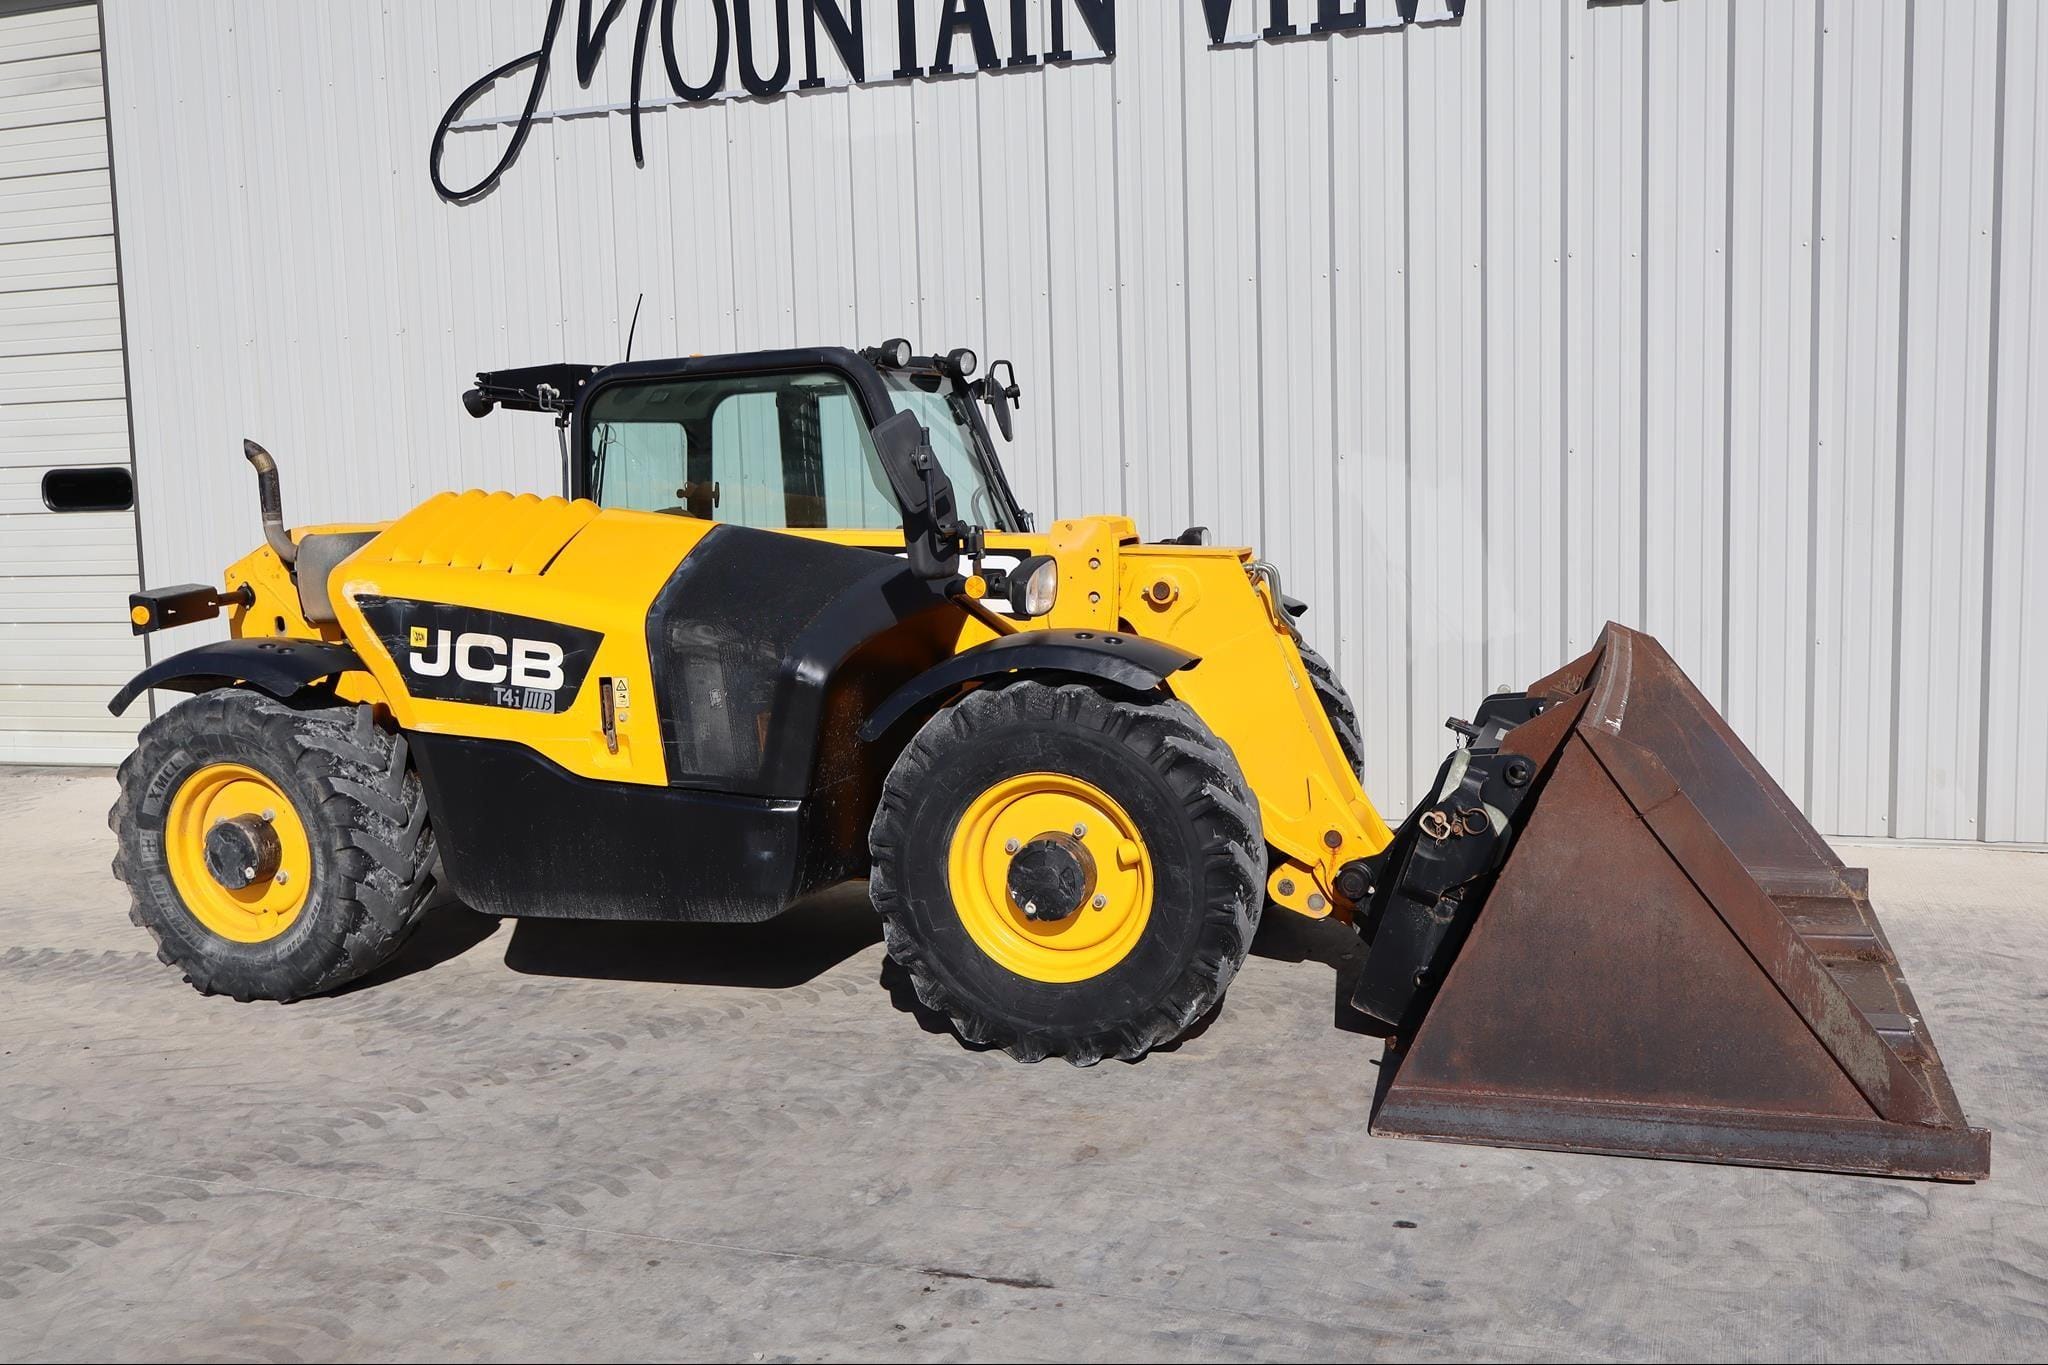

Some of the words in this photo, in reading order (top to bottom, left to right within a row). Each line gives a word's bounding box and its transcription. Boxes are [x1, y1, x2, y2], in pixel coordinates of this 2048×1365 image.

[409, 628, 565, 691] JCB
[493, 686, 520, 708] T4i
[147, 760, 183, 803] XMCL
